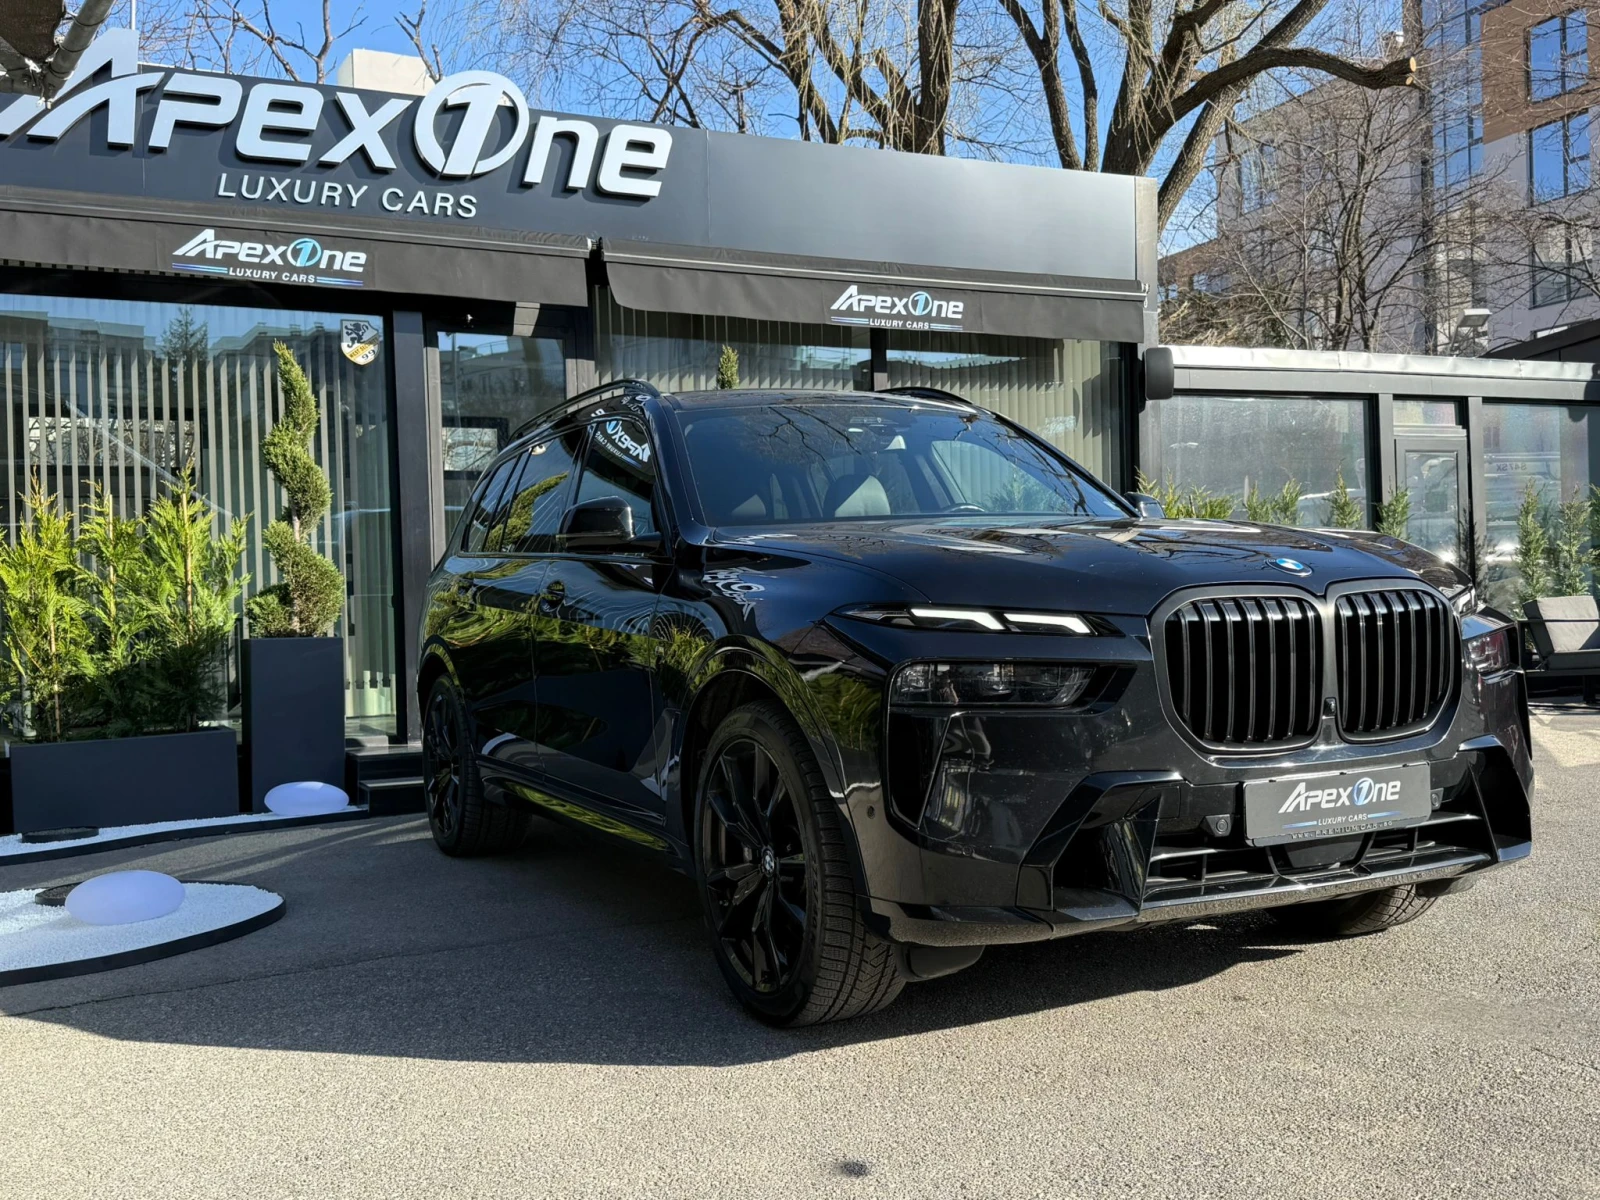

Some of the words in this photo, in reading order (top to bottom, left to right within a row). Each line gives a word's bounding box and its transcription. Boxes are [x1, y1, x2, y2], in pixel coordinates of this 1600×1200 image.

[218, 173, 368, 207] LUXURY
[381, 187, 478, 218] CARS
[228, 266, 278, 280] LUXURY
[282, 272, 316, 283] CARS
[869, 318, 903, 328] LUXURY
[906, 320, 930, 330] CARS
[361, 349, 376, 360] 99
[1318, 815, 1347, 826] LUXURY
[1348, 813, 1369, 823] CARS
